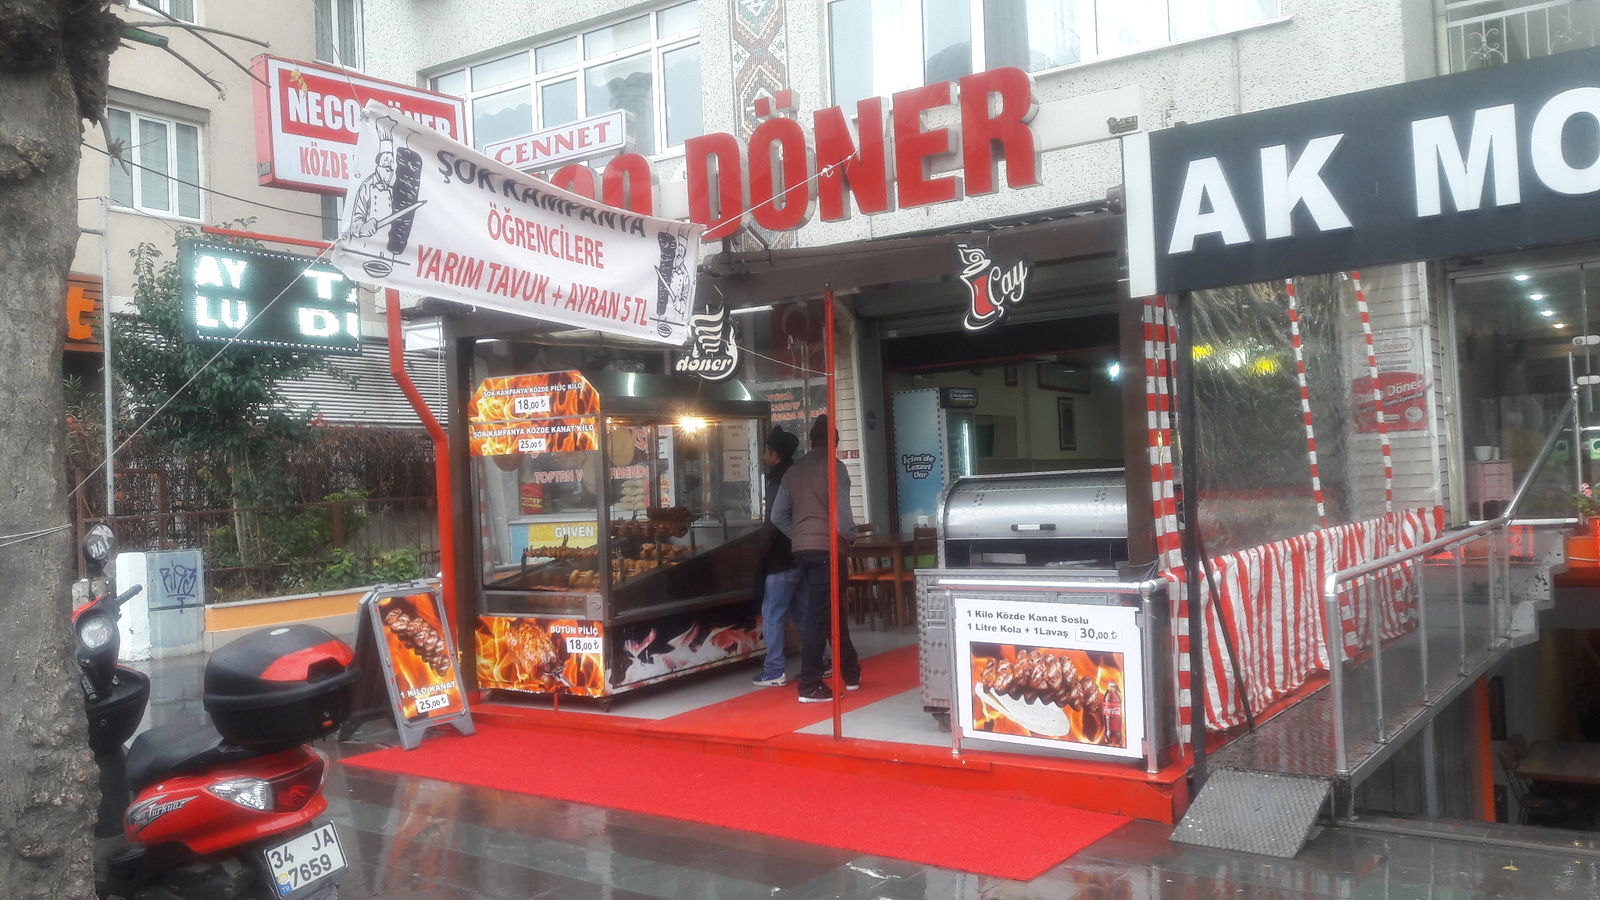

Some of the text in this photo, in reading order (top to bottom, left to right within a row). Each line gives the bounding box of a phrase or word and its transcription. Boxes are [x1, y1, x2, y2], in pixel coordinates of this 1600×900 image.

[287, 87, 360, 134] NECO
[495, 120, 611, 168] CENNET
[685, 67, 1041, 240] DÖNER
[299, 142, 349, 181] KÖZDE
[437, 150, 500, 194] ŞOK
[502, 178, 646, 238] KAMPANYA
[1168, 134, 1354, 255] AK
[487, 202, 604, 269] ÖĞRENCİLERE
[195, 255, 247, 289] AY
[415, 245, 647, 325] YARIM TAVUK + AYRAN 5 TL
[987, 260, 1028, 317] Çay
[196, 296, 249, 330] LU
[496, 388, 528, 396] KAMPANYA
[1387, 380, 1423, 396] Döner
[489, 428, 525, 438] KAMPANYA
[550, 625, 598, 637] BÜTÜN PİLİÇ
[975, 610, 993, 619] Kilo
[996, 611, 1026, 621] Közde
[1028, 613, 1058, 623] Kanat
[1061, 615, 1089, 625] Soslu
[975, 623, 998, 632] Litre
[1000, 625, 1022, 634] Kola
[1033, 626, 1069, 638] 1Lavaş
[1080, 627, 1108, 641] 30,00
[569, 639, 592, 651] 18,00
[429, 680, 456, 693] KANAT
[419, 698, 441, 712] 25,00
[271, 828, 335, 869] 34 JA
[288, 853, 331, 887] 7659
